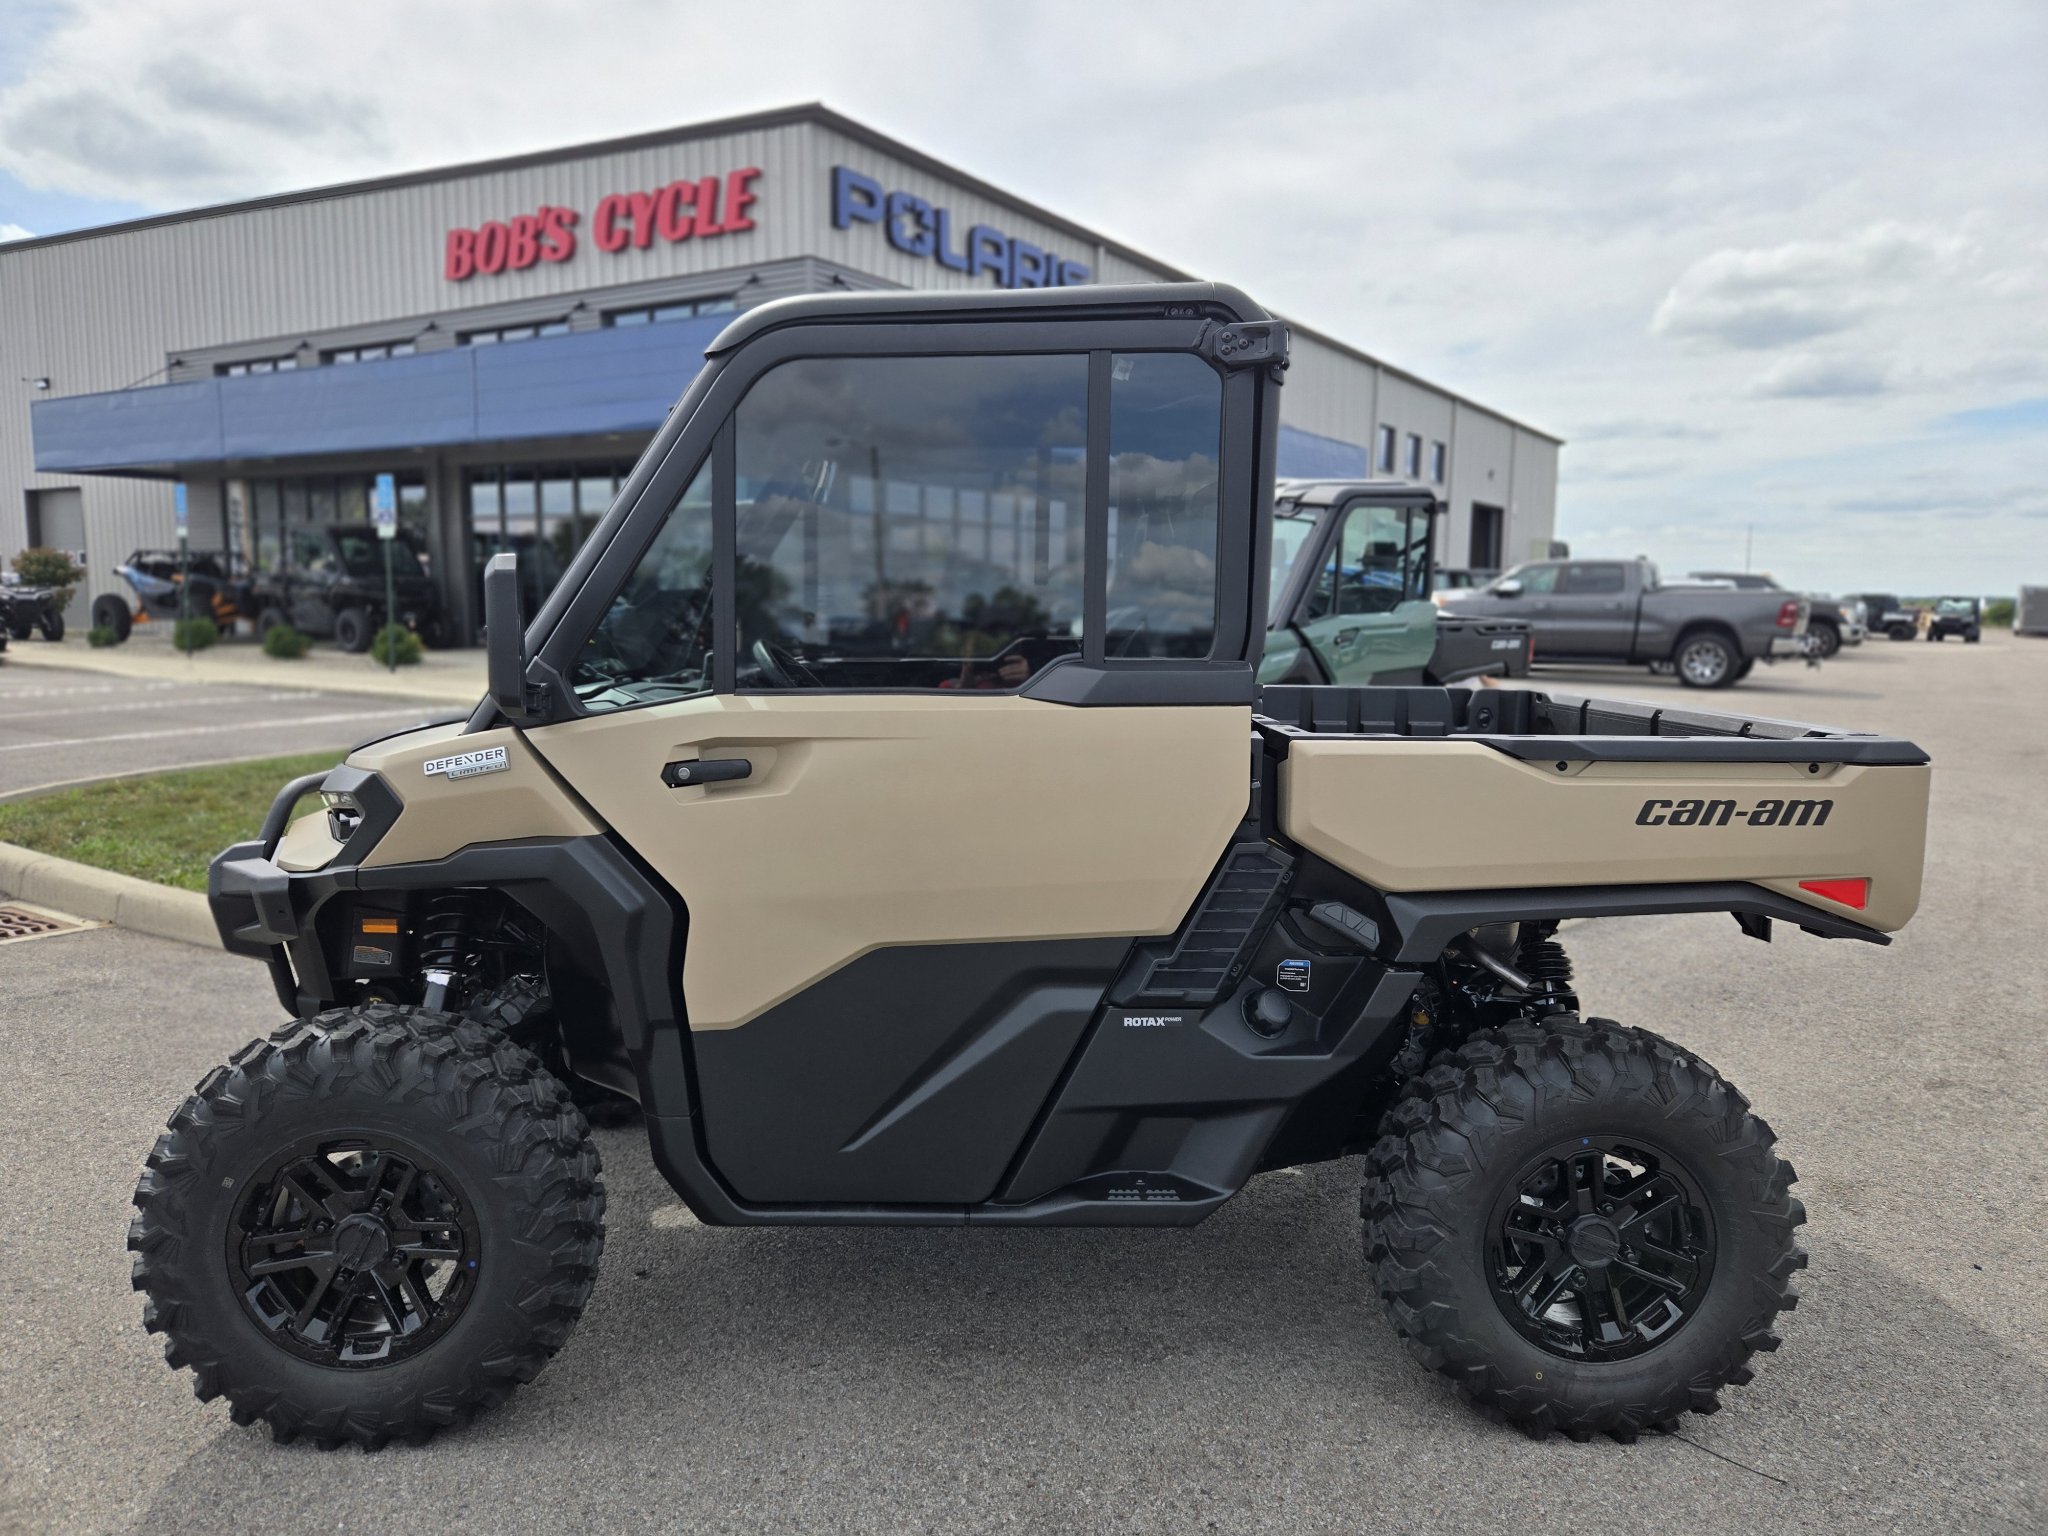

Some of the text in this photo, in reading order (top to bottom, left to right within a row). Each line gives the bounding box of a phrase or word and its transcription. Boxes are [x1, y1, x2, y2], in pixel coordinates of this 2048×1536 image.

[444, 167, 762, 281] BOB'S CYCLE
[426, 749, 504, 772] DEFENDER
[1635, 799, 1834, 826] can-am
[1124, 1017, 1165, 1027] ROTAX
